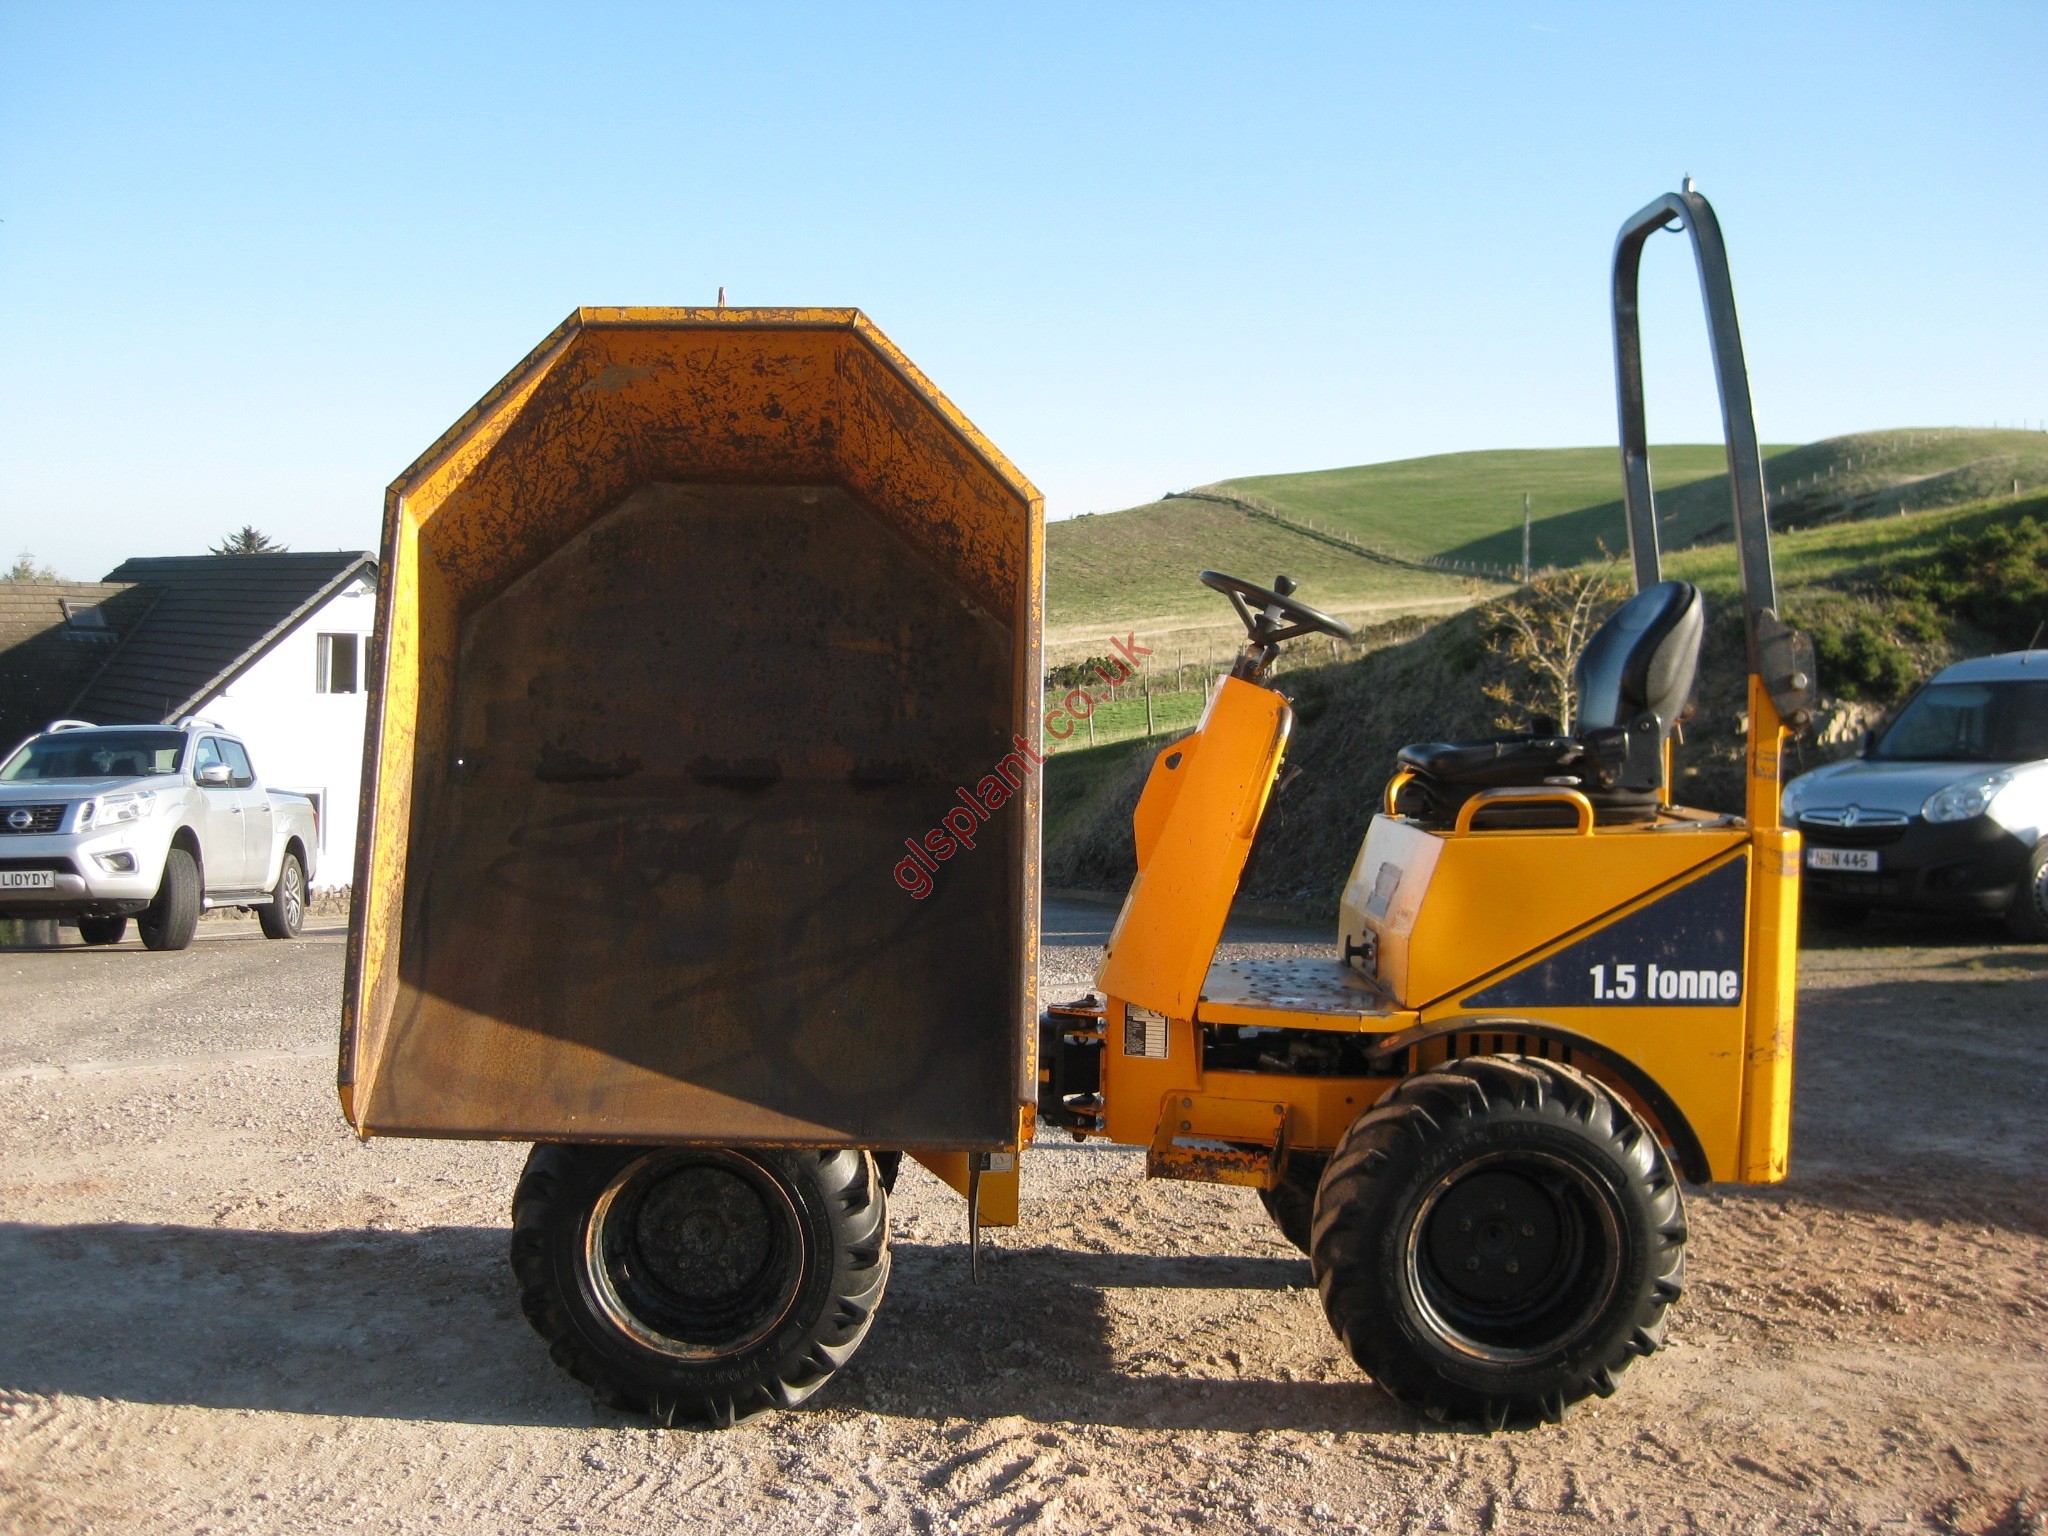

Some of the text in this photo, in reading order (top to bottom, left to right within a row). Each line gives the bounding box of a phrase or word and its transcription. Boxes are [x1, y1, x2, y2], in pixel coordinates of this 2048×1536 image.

[1843, 853, 1868, 868] 445
[1589, 963, 1738, 1000] 1.5 tonne
